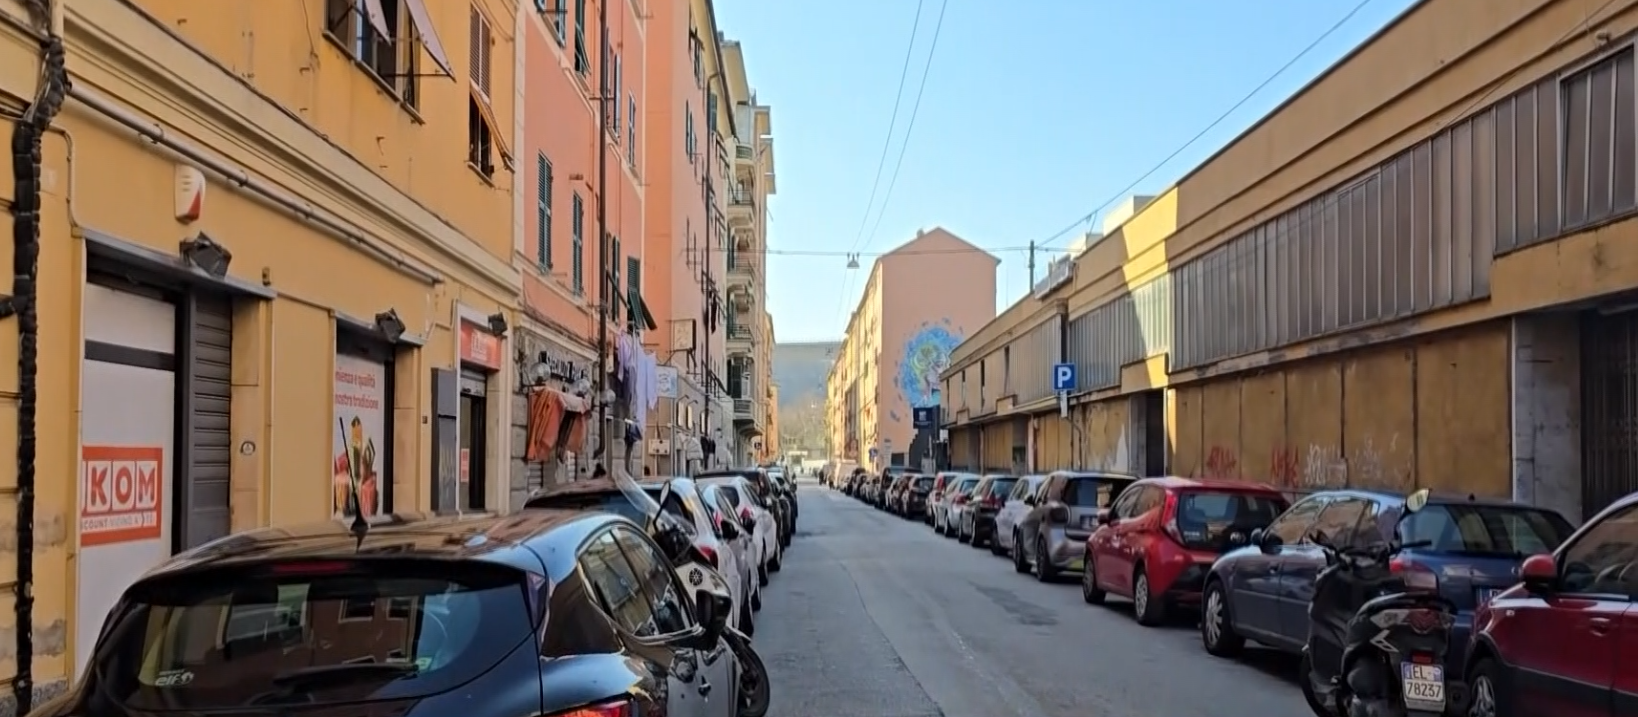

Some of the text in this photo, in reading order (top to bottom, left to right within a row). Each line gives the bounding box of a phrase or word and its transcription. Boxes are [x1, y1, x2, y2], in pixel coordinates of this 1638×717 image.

[1057, 366, 1072, 388] P
[155, 673, 181, 686] elf
[1412, 664, 1428, 680] EL
[1406, 681, 1442, 699] 78237
